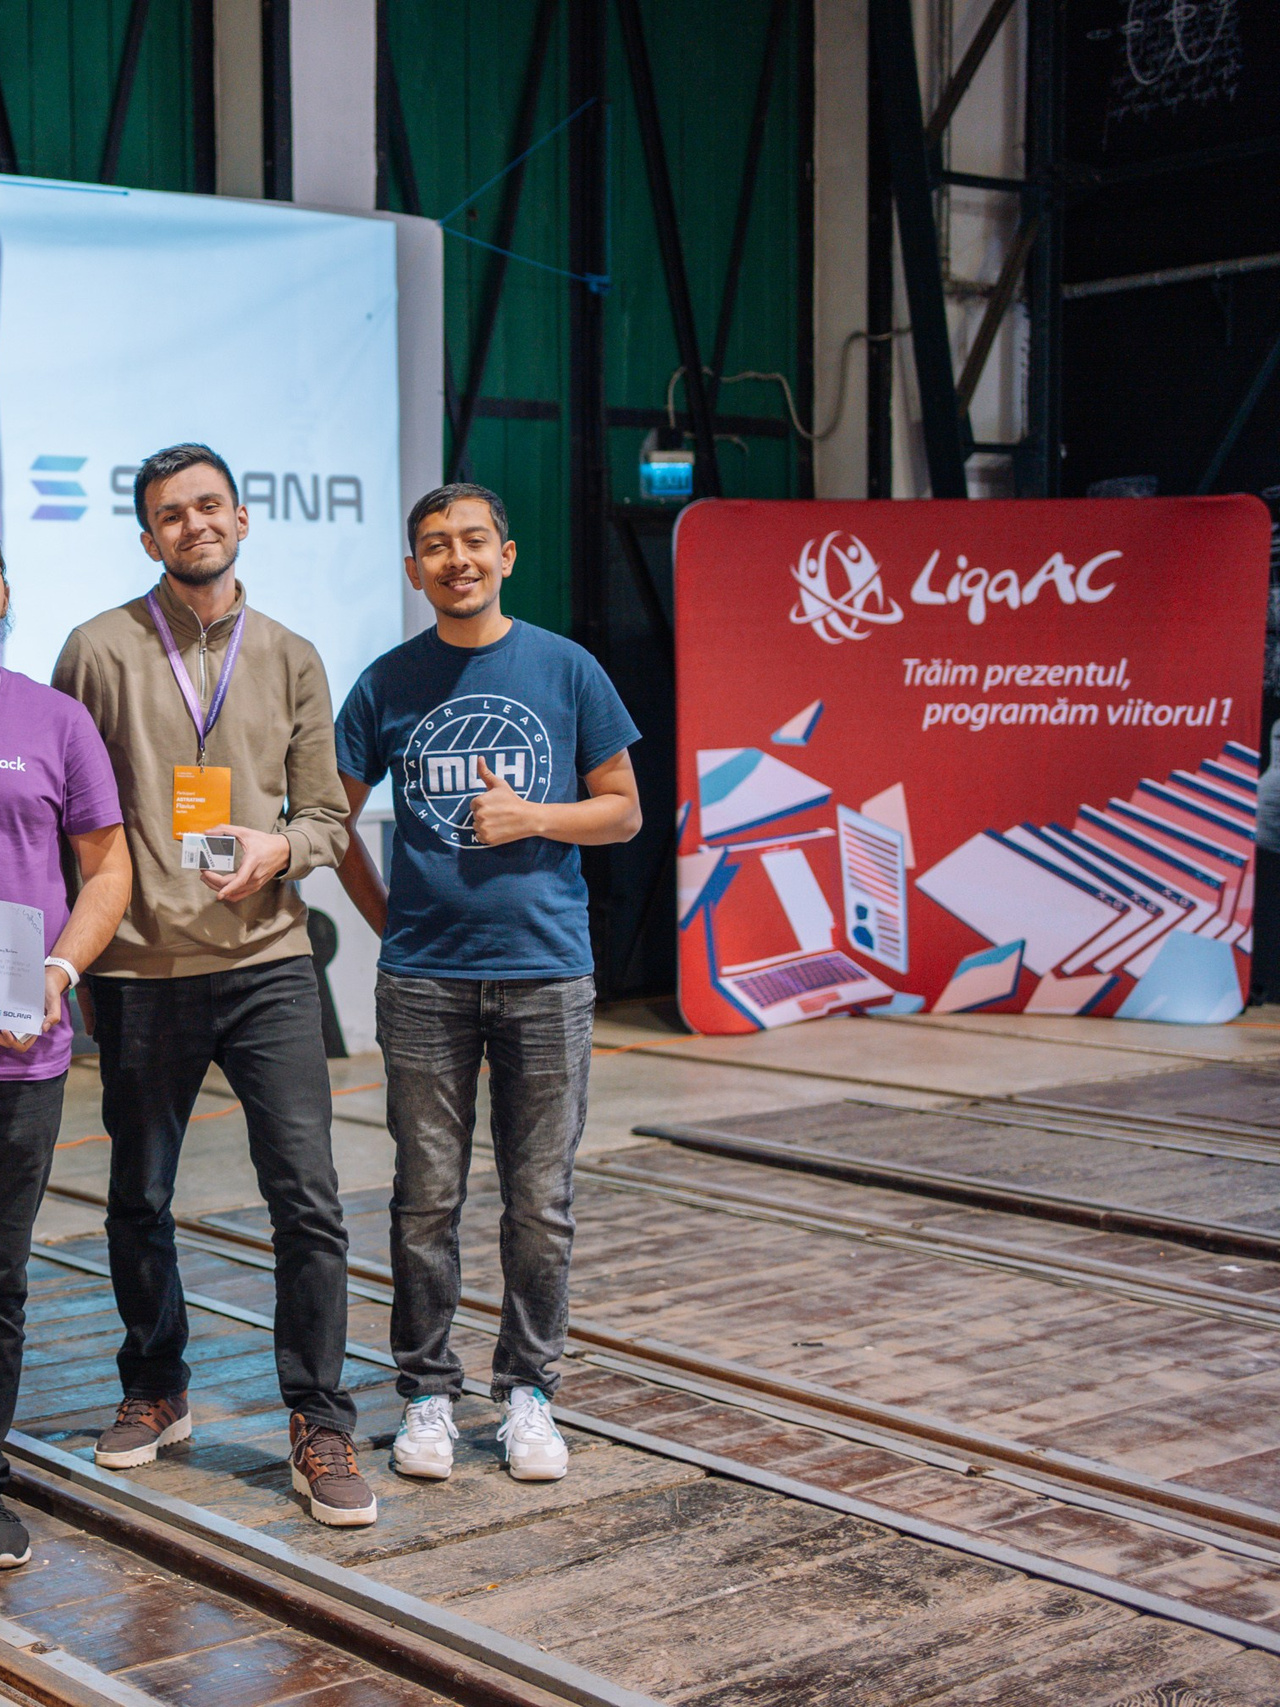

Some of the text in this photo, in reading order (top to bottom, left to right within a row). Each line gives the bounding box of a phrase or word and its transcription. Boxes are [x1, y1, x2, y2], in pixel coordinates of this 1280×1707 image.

[111, 465, 364, 523] SANA
[902, 657, 1131, 692] Trăim prezentul,
[923, 698, 1098, 733] programăm
[408, 700, 547, 789] MAJOR LEAGUE
[427, 752, 525, 792] MLH
[418, 808, 479, 843] HACK
[3, 1010, 32, 1020] SOLANA
